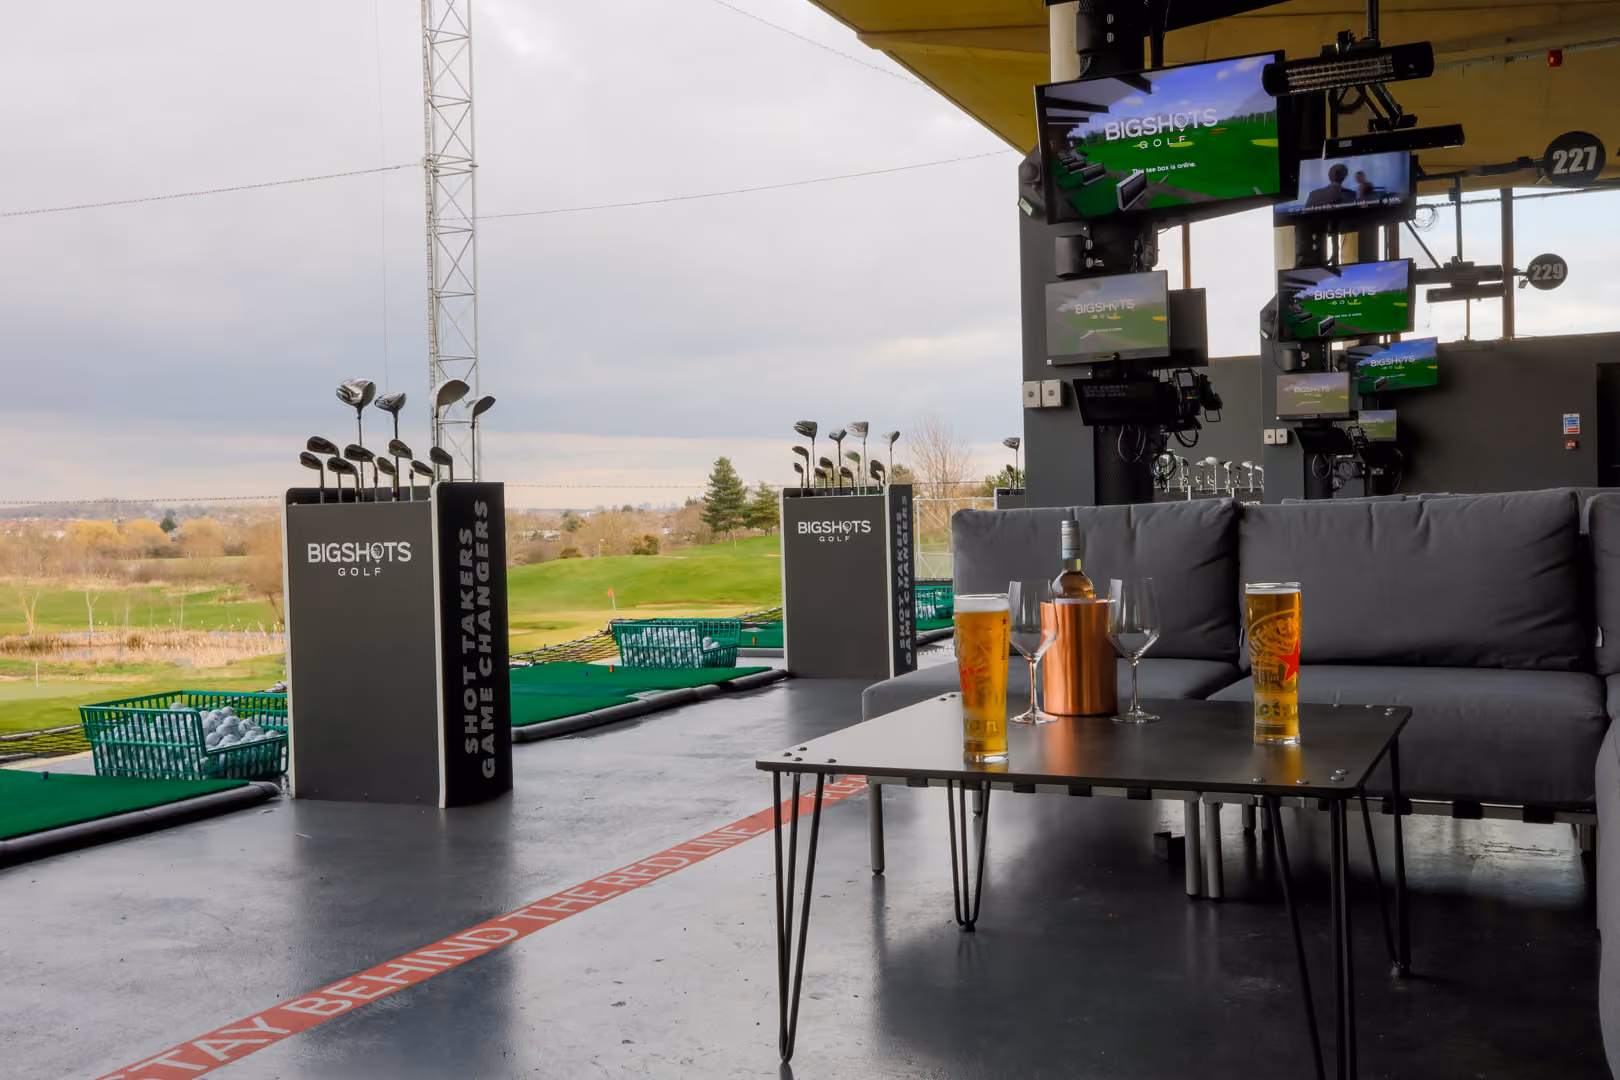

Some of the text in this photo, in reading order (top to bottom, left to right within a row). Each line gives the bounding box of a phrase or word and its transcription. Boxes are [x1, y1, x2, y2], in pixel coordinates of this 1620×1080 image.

[1105, 108, 1218, 141] BIGSHOTS
[1139, 135, 1186, 149] GOLF
[1552, 146, 1597, 175] 227
[1531, 263, 1564, 281] 229
[1314, 286, 1376, 301] BIGSHOTS
[1075, 299, 1136, 314] BIGSHOTS
[1370, 355, 1416, 367] BIGSHOTS
[797, 520, 872, 535] BIGSHOTS
[307, 541, 412, 564] BIGSHOTS
[901, 495, 910, 602] CHANGERS
[337, 567, 382, 577] GOLF
[896, 512, 906, 649] SHOT TAKERS
[459, 528, 479, 755] SHOT TAKERS
[474, 500, 496, 779] GAME CHANGERS
[97, 1016, 291, 1080] TAY
[279, 927, 519, 1016] BEHIND
[498, 886, 622, 921] THE
[595, 856, 690, 887] RED
[670, 826, 767, 855] LINE
